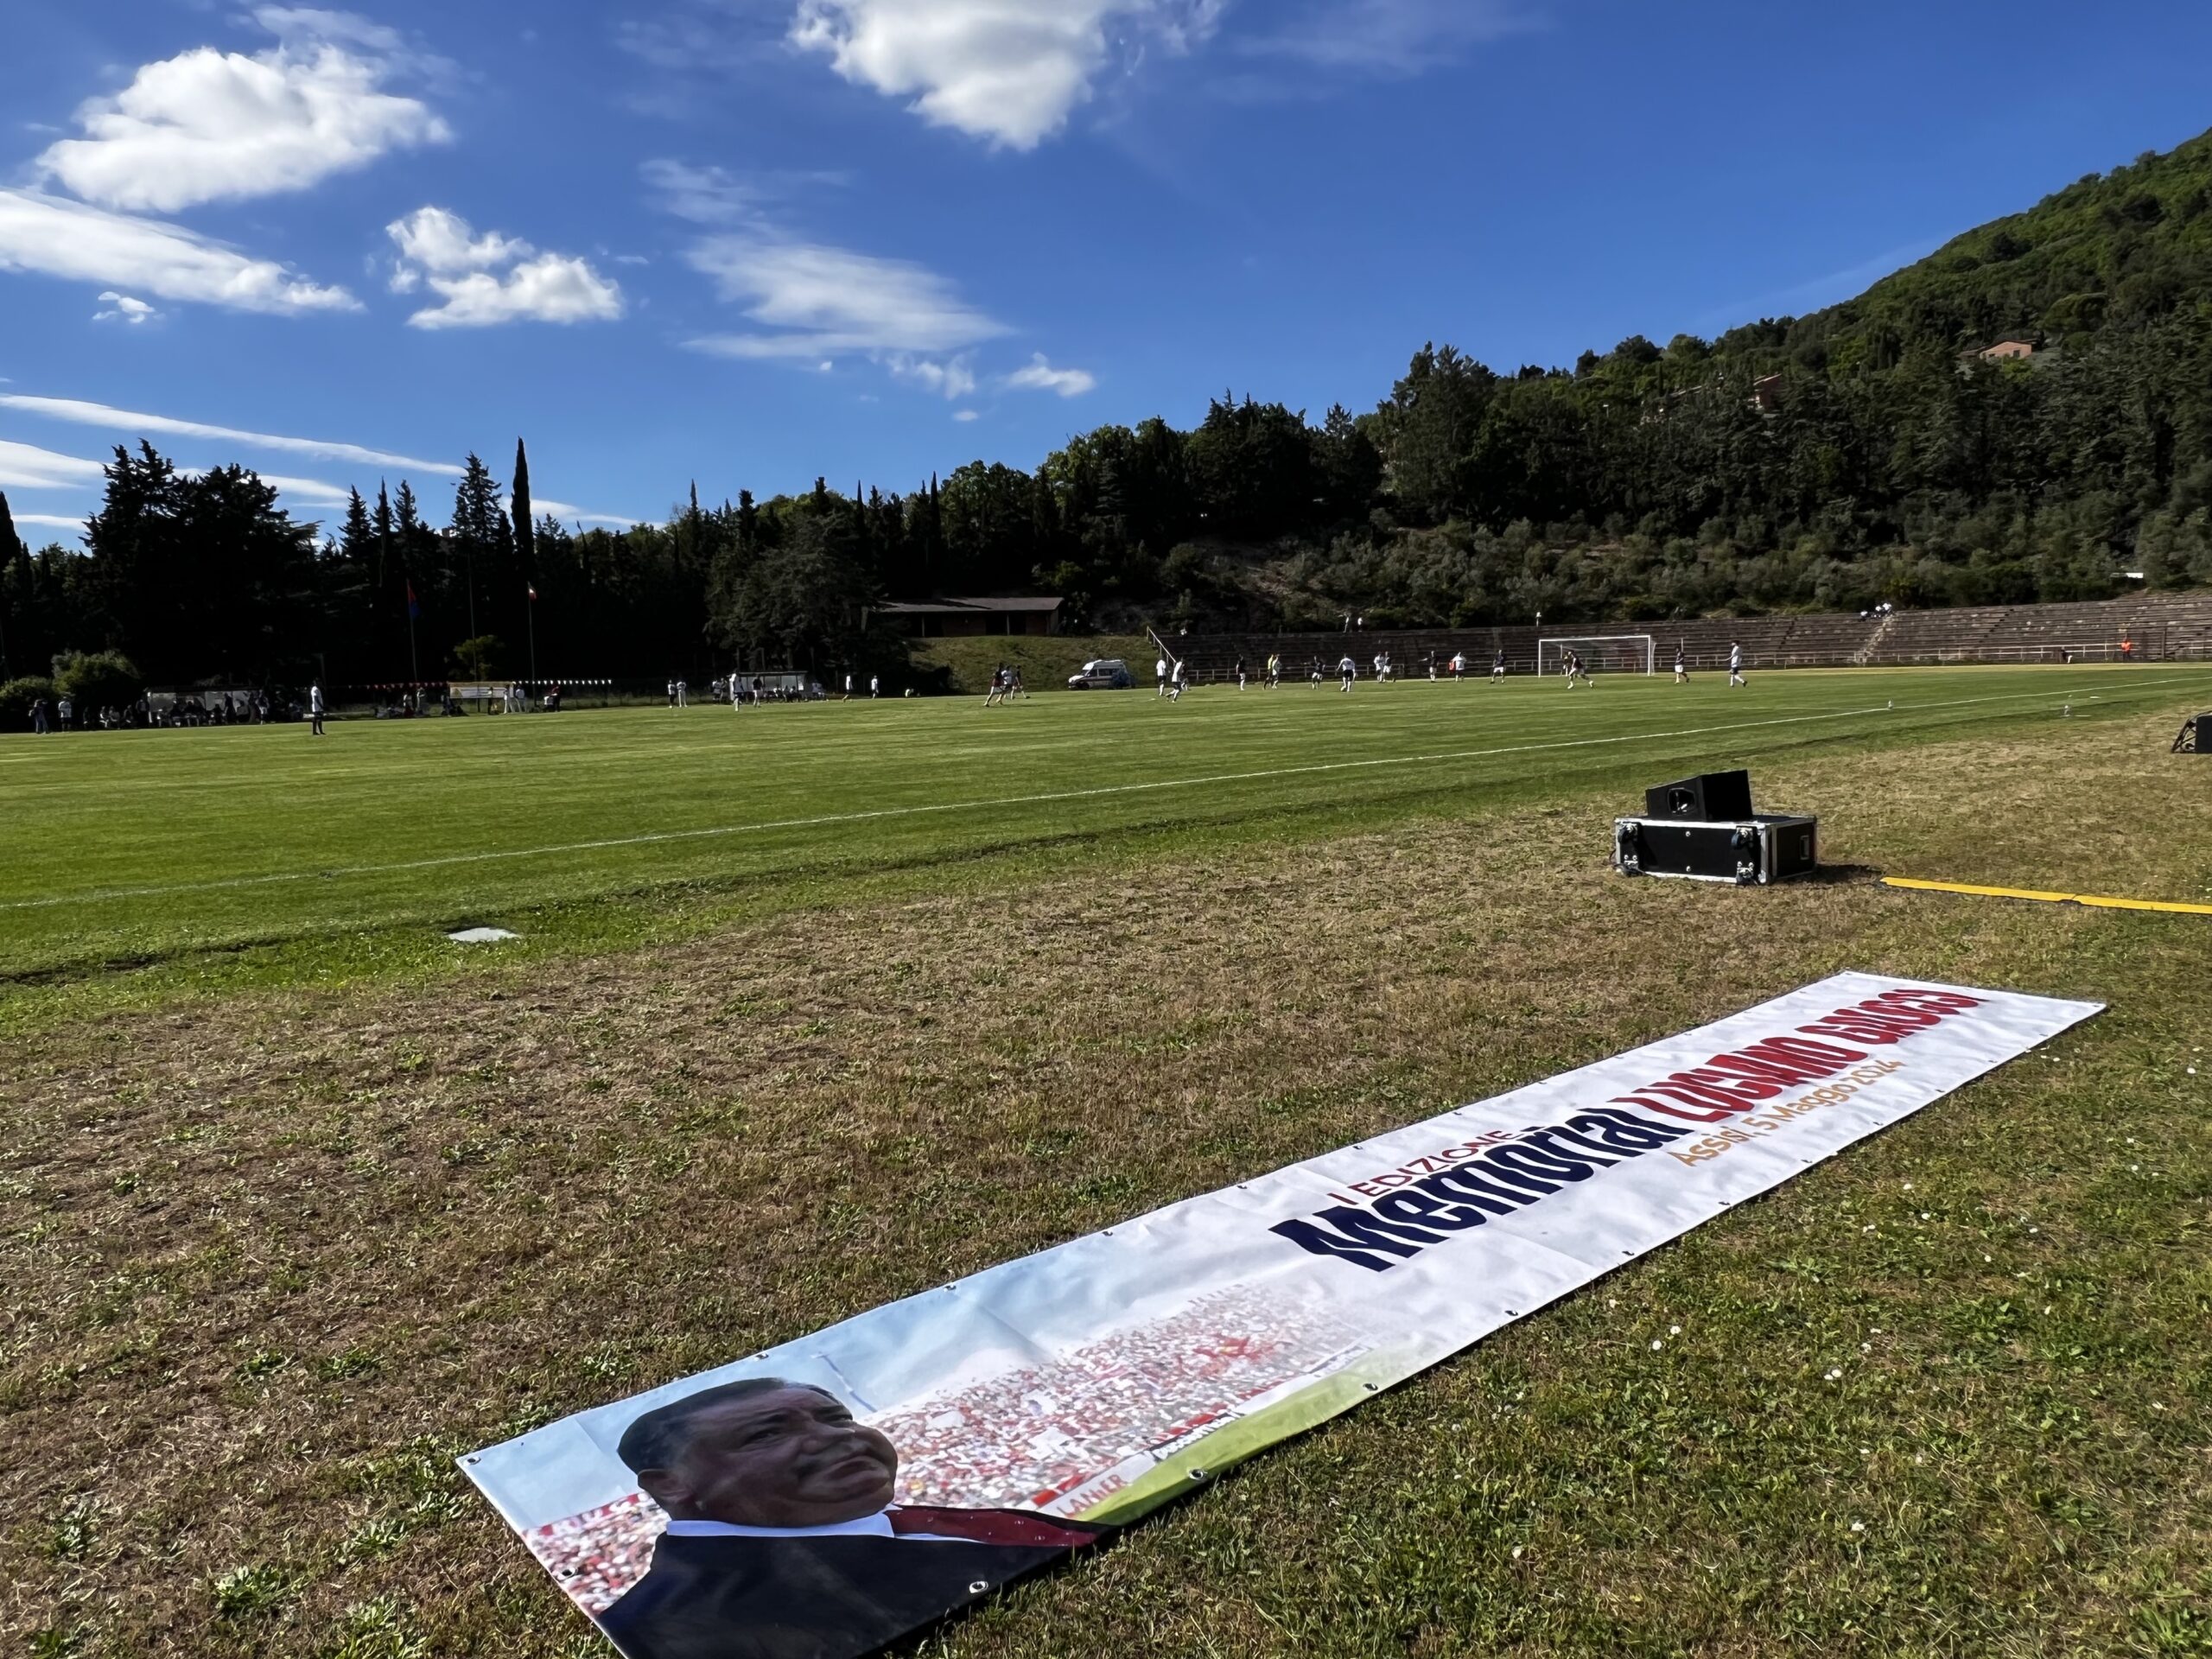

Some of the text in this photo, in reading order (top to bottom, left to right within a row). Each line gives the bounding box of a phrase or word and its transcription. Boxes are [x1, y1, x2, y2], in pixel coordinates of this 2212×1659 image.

[1267, 988, 1990, 1273] Memorial LUCIANO GAUCCI
[1326, 1129, 1515, 1205] I EDIZIONE
[1667, 1058, 1907, 1167] Assisi, 5 Maggio 2024
